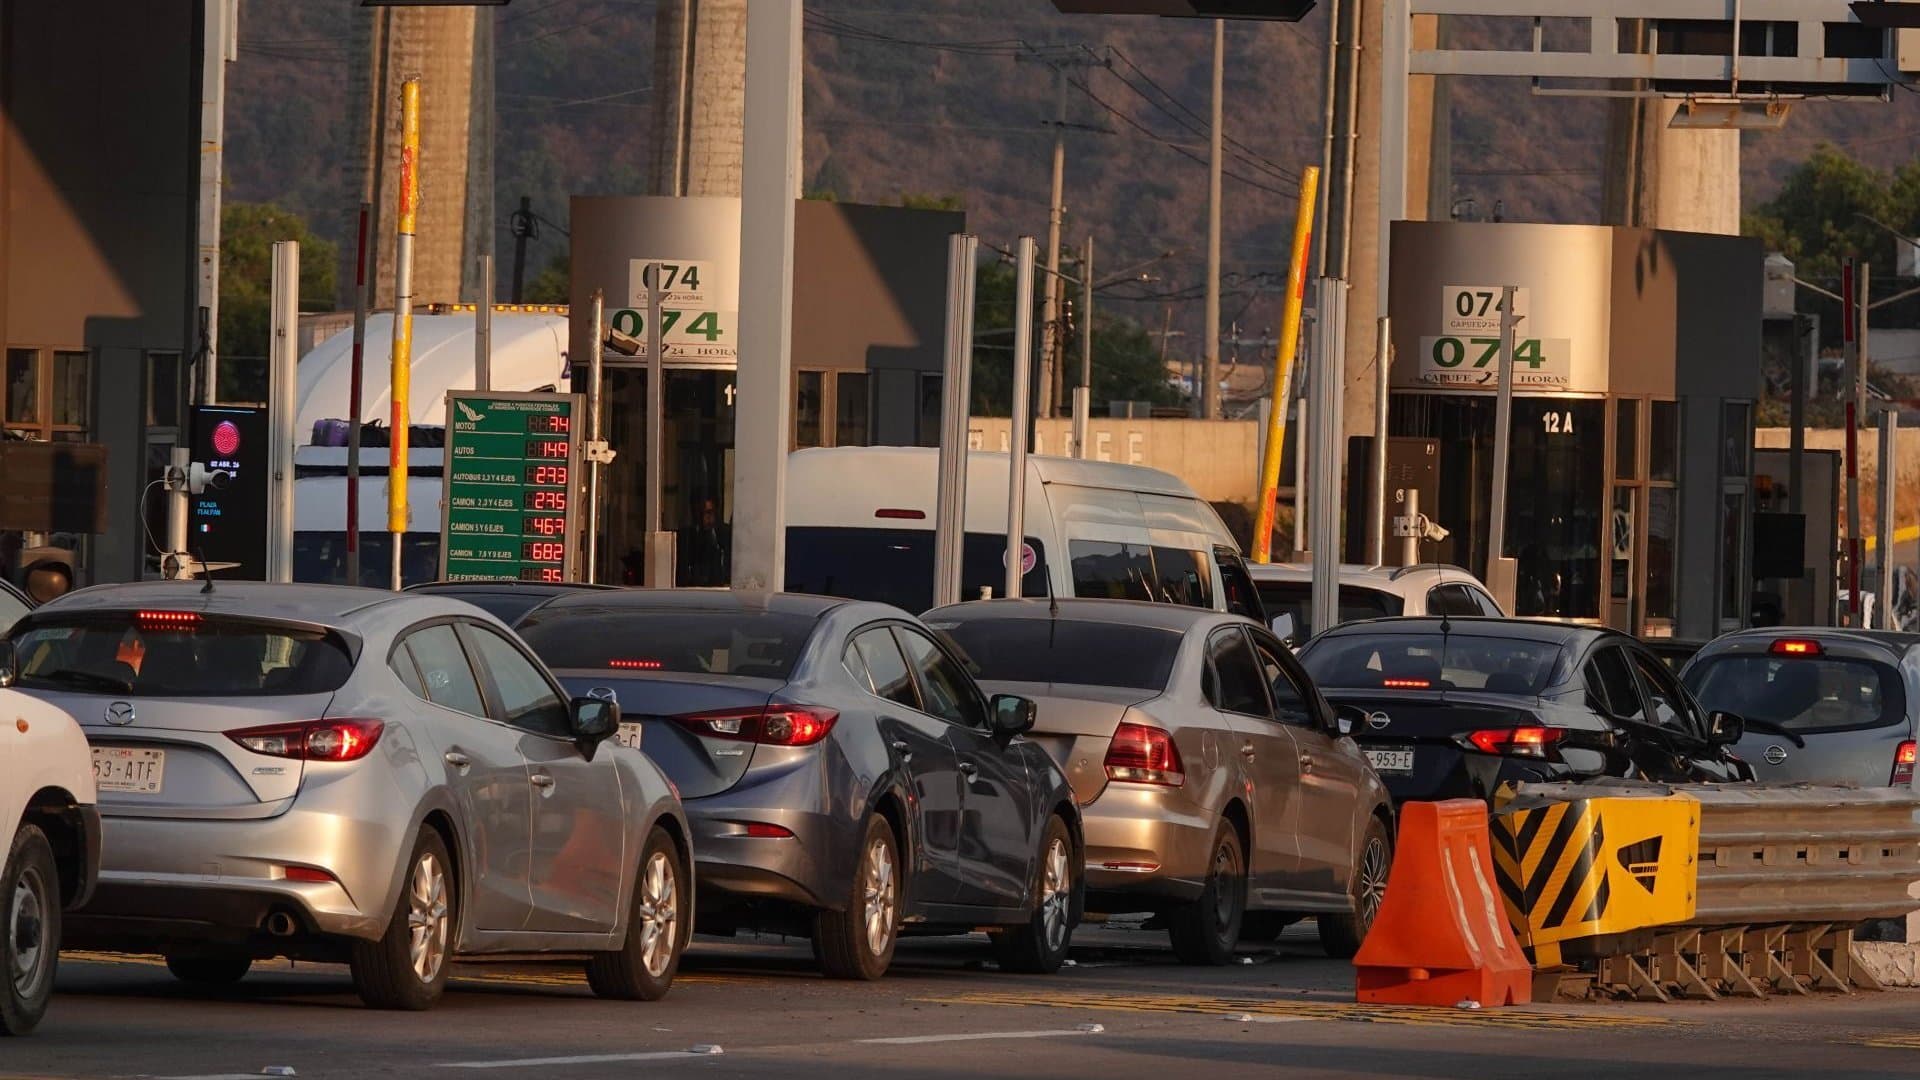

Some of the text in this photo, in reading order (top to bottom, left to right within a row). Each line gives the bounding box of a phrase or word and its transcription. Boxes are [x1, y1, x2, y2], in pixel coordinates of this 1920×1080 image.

[612, 309, 723, 342] 074
[697, 348, 737, 356] HORA
[1432, 337, 1546, 369] 074
[1424, 374, 1472, 383] CAPUFE
[1520, 375, 1568, 384] HORAS
[724, 383, 737, 406] 1
[455, 422, 476, 431] MOTOS
[1543, 412, 1574, 433] 12 A
[454, 446, 475, 455] AUTOS
[544, 442, 568, 458] 149
[452, 498, 475, 506] CAMION
[450, 523, 475, 531] CAMION
[489, 524, 504, 532] EJES
[532, 543, 563, 560] 682
[1364, 751, 1411, 768] -953-E
